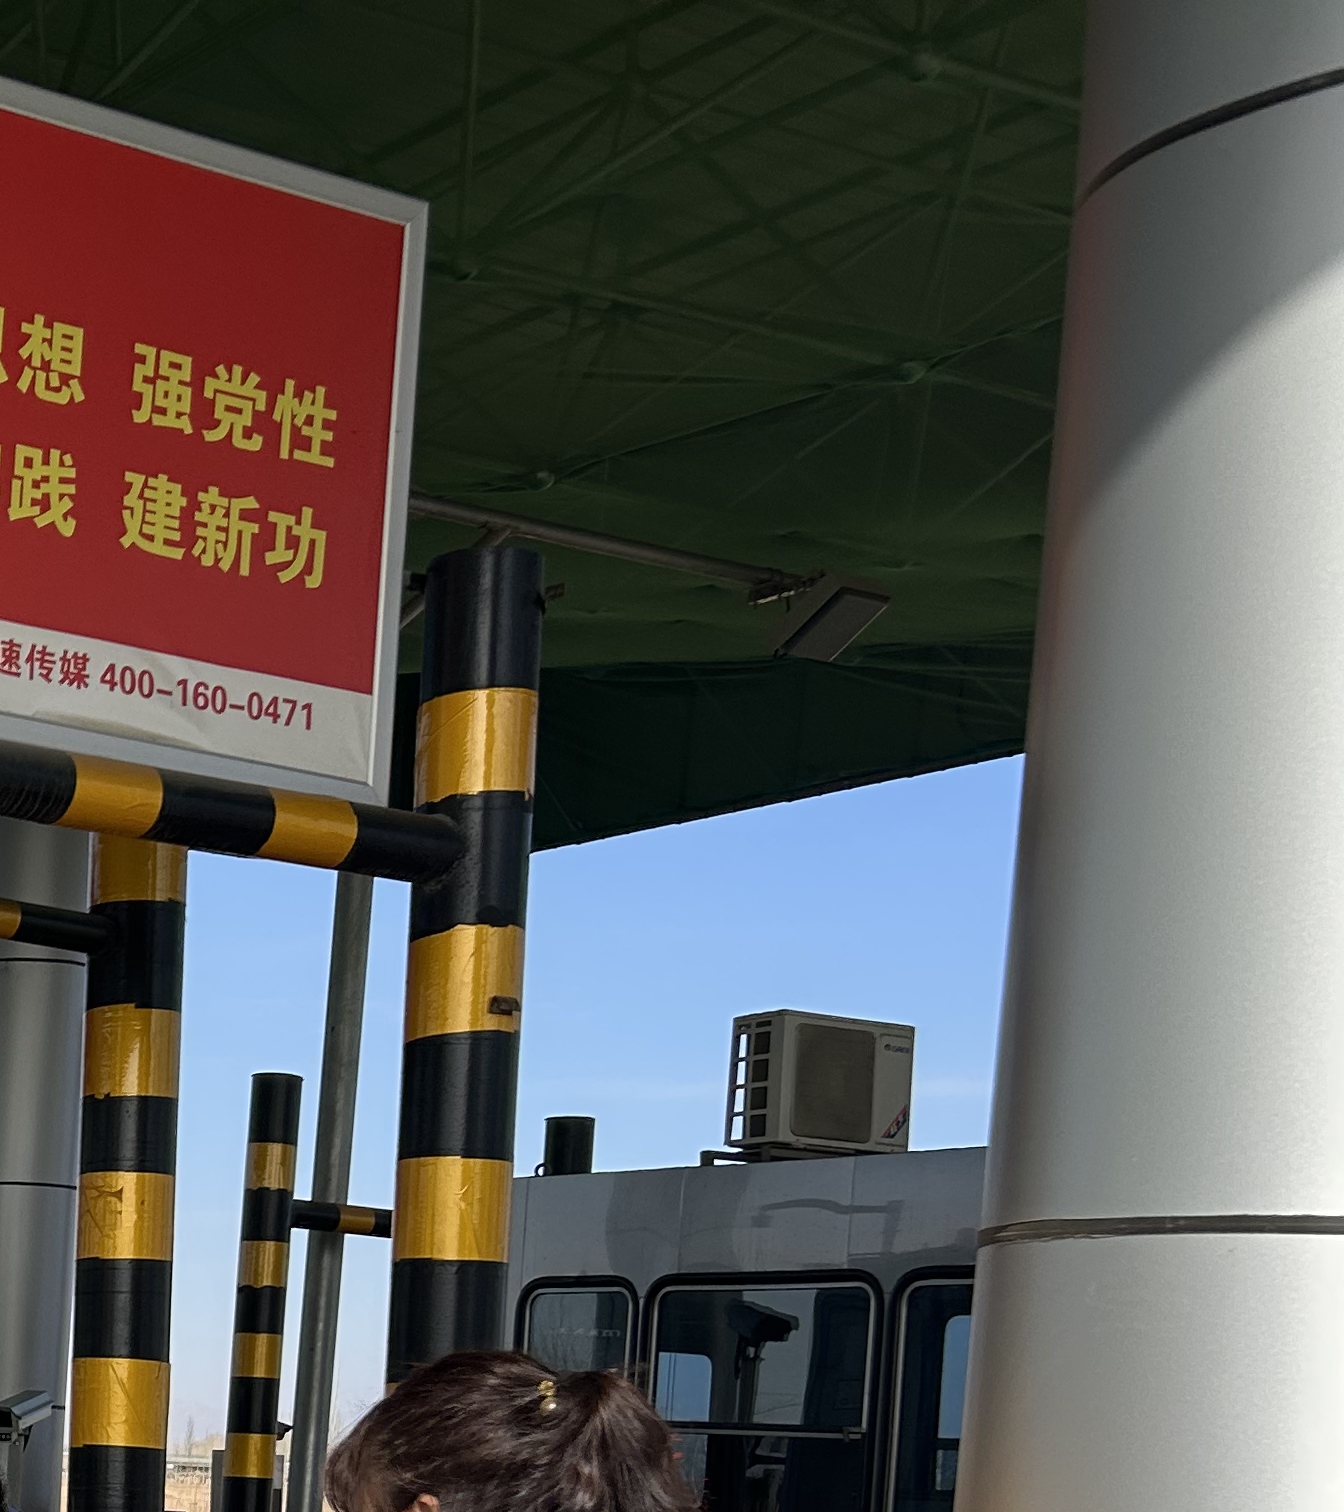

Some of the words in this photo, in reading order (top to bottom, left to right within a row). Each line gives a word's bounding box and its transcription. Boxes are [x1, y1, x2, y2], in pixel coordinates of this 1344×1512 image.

[131, 342, 338, 468] 强党性
[119, 471, 328, 589] 建新功
[100, 662, 314, 731] 400-160-0471
